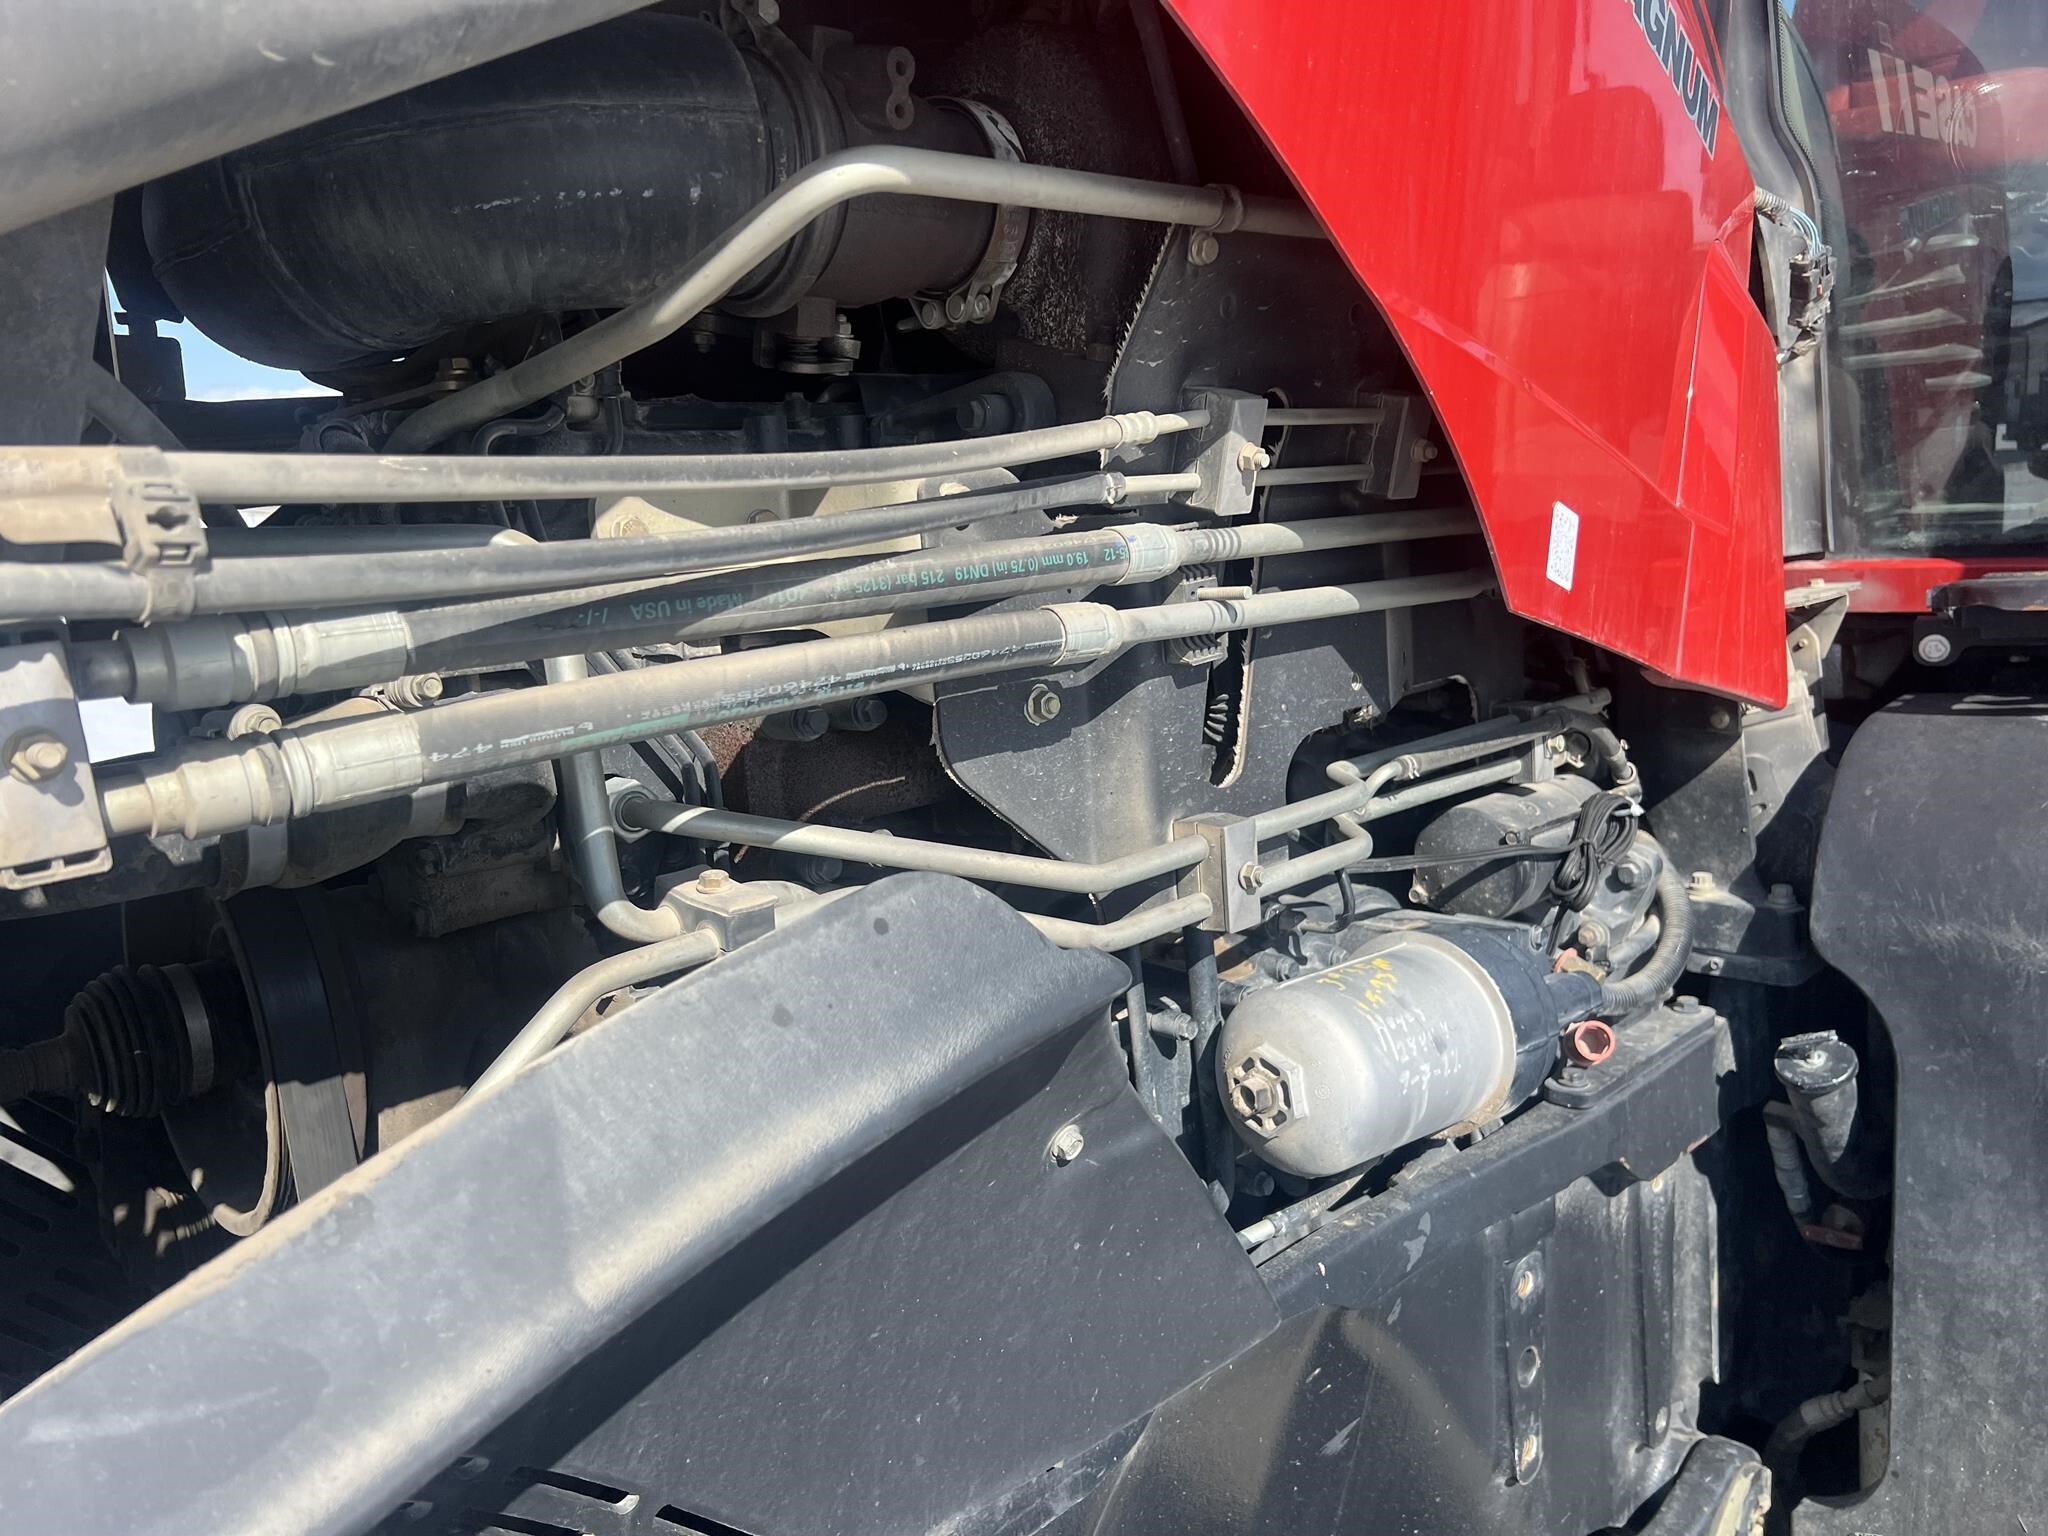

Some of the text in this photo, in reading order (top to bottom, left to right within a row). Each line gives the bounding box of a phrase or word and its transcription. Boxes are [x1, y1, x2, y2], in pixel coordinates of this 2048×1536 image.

[1011, 556, 1039, 573] (0.75
[1042, 556, 1063, 566] mm
[1066, 551, 1089, 566] 19.0
[895, 573, 917, 586] bar
[921, 569, 945, 585] 215
[954, 565, 989, 581] DN19
[855, 575, 891, 593] (3125
[676, 599, 692, 615] in
[696, 592, 744, 612] Made
[629, 601, 671, 620] USA
